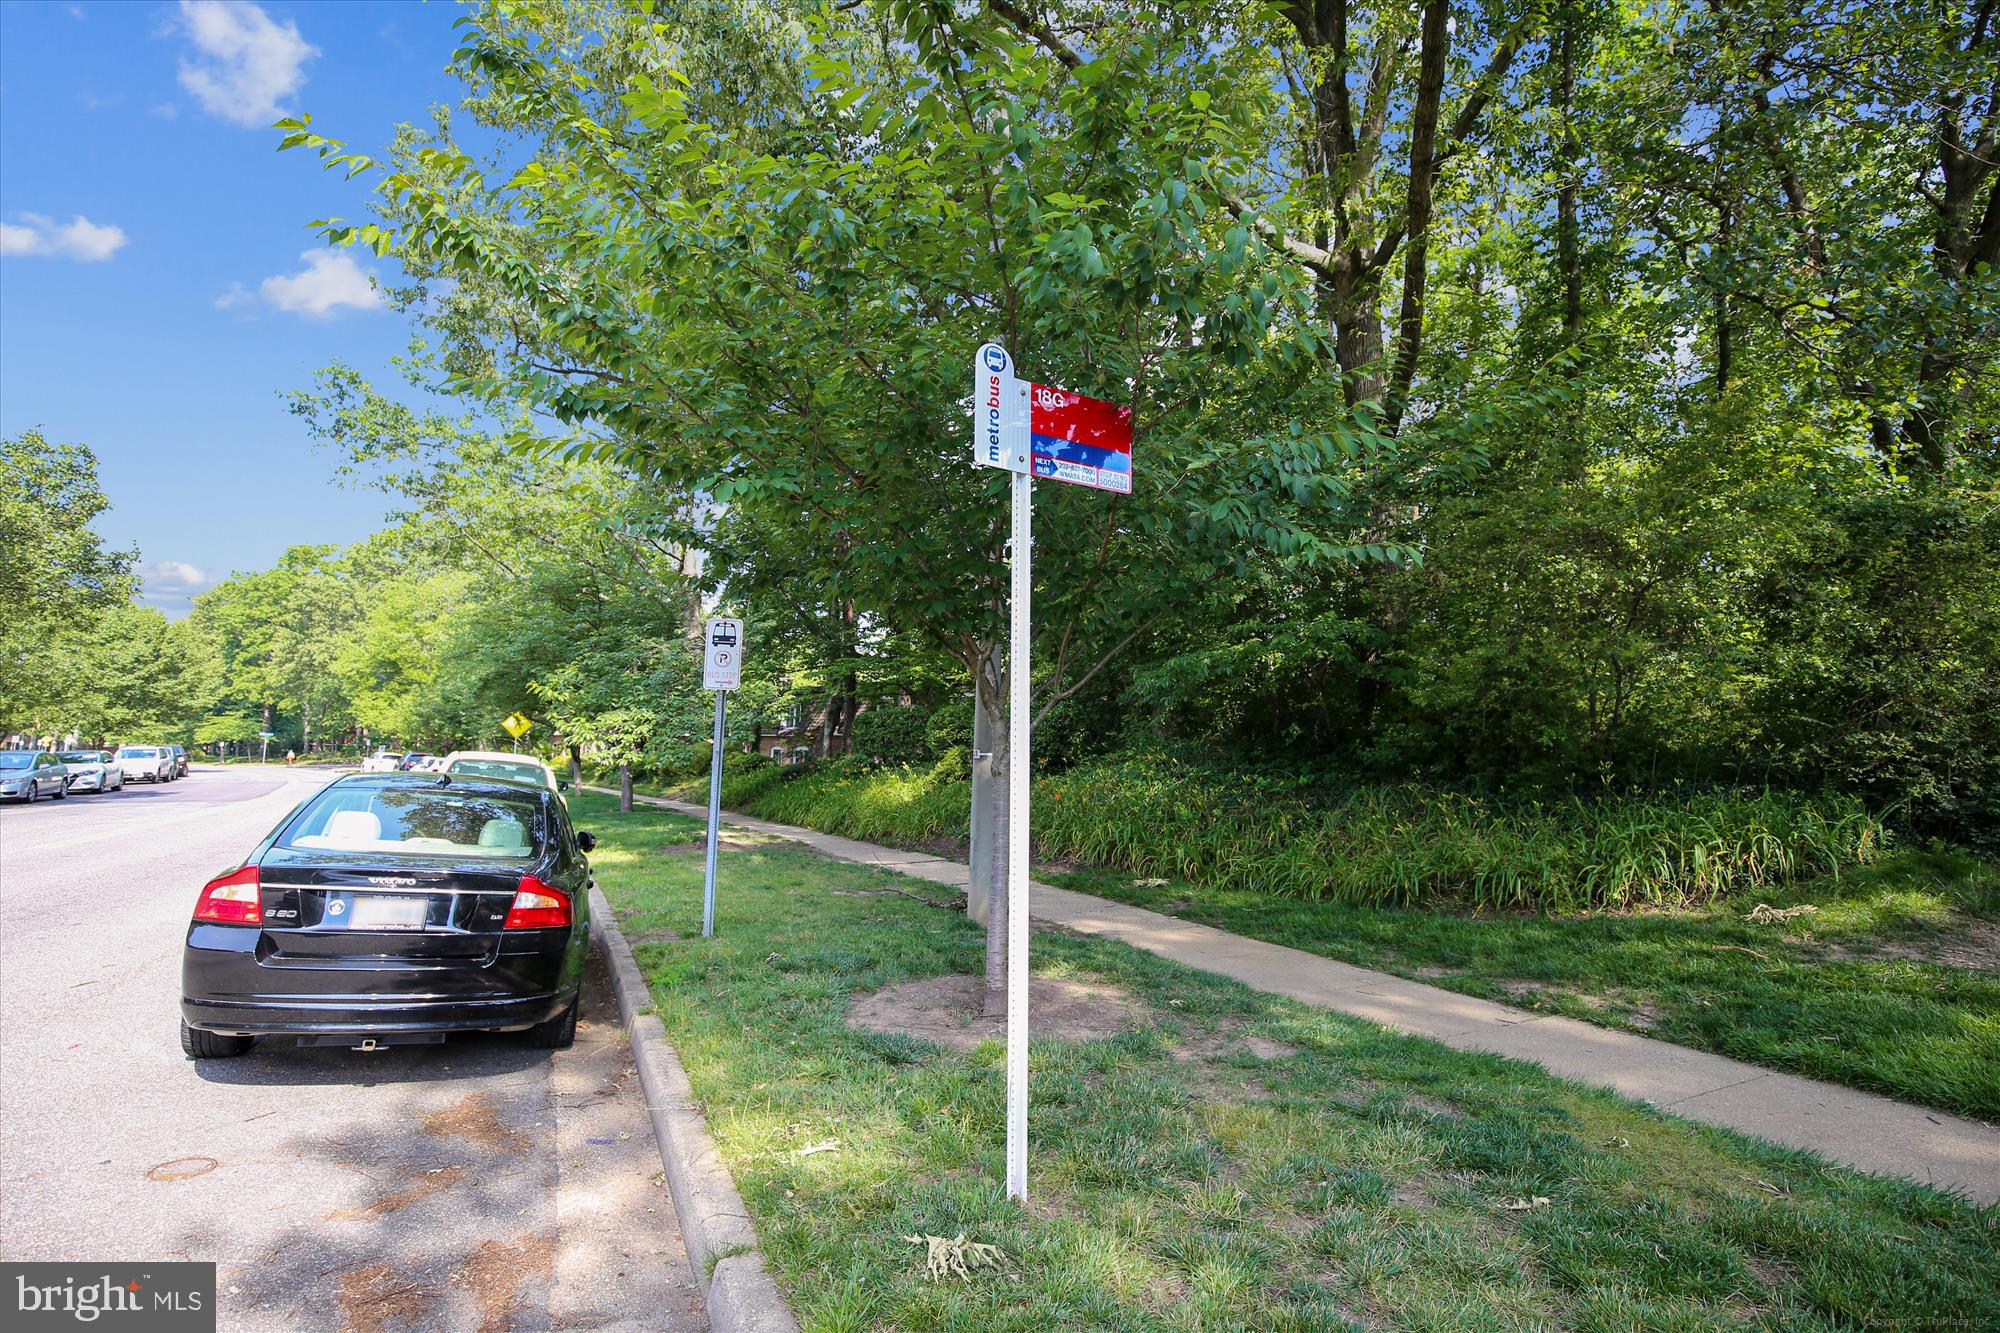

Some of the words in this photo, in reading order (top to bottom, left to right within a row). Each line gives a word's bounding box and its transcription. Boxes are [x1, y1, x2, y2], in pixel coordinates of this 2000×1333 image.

[1034, 388, 1064, 408] 18G
[987, 375, 1000, 462] metrobus
[1035, 457, 1051, 466] NEXT
[1036, 466, 1050, 474] BUS
[1059, 471, 1096, 483] WMATA.COM
[1099, 477, 1128, 490] 5000284
[707, 671, 720, 679] BUS
[721, 671, 738, 679] STOP
